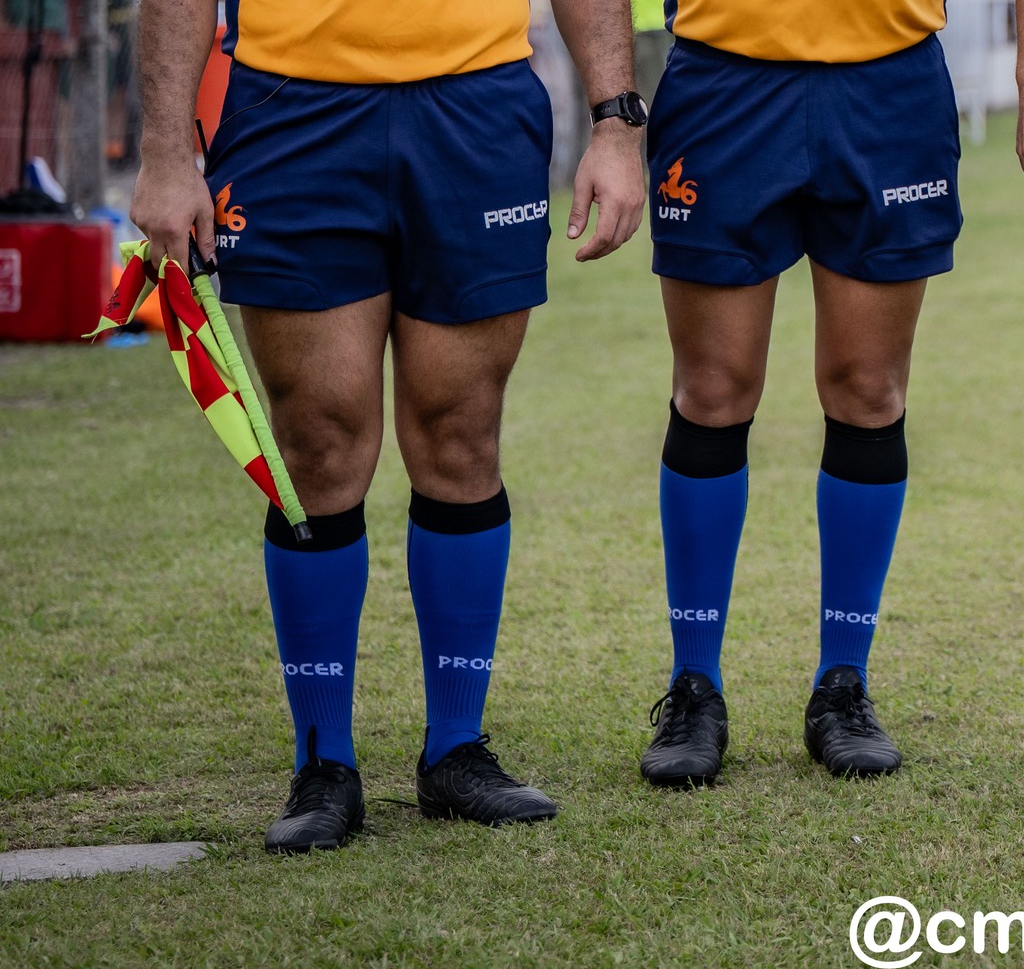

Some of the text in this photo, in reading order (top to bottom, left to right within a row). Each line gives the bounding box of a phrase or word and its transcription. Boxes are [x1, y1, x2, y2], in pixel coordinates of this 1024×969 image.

[882, 178, 948, 207] PROCER
[483, 199, 548, 229] PROCER
[658, 205, 691, 222] URT
